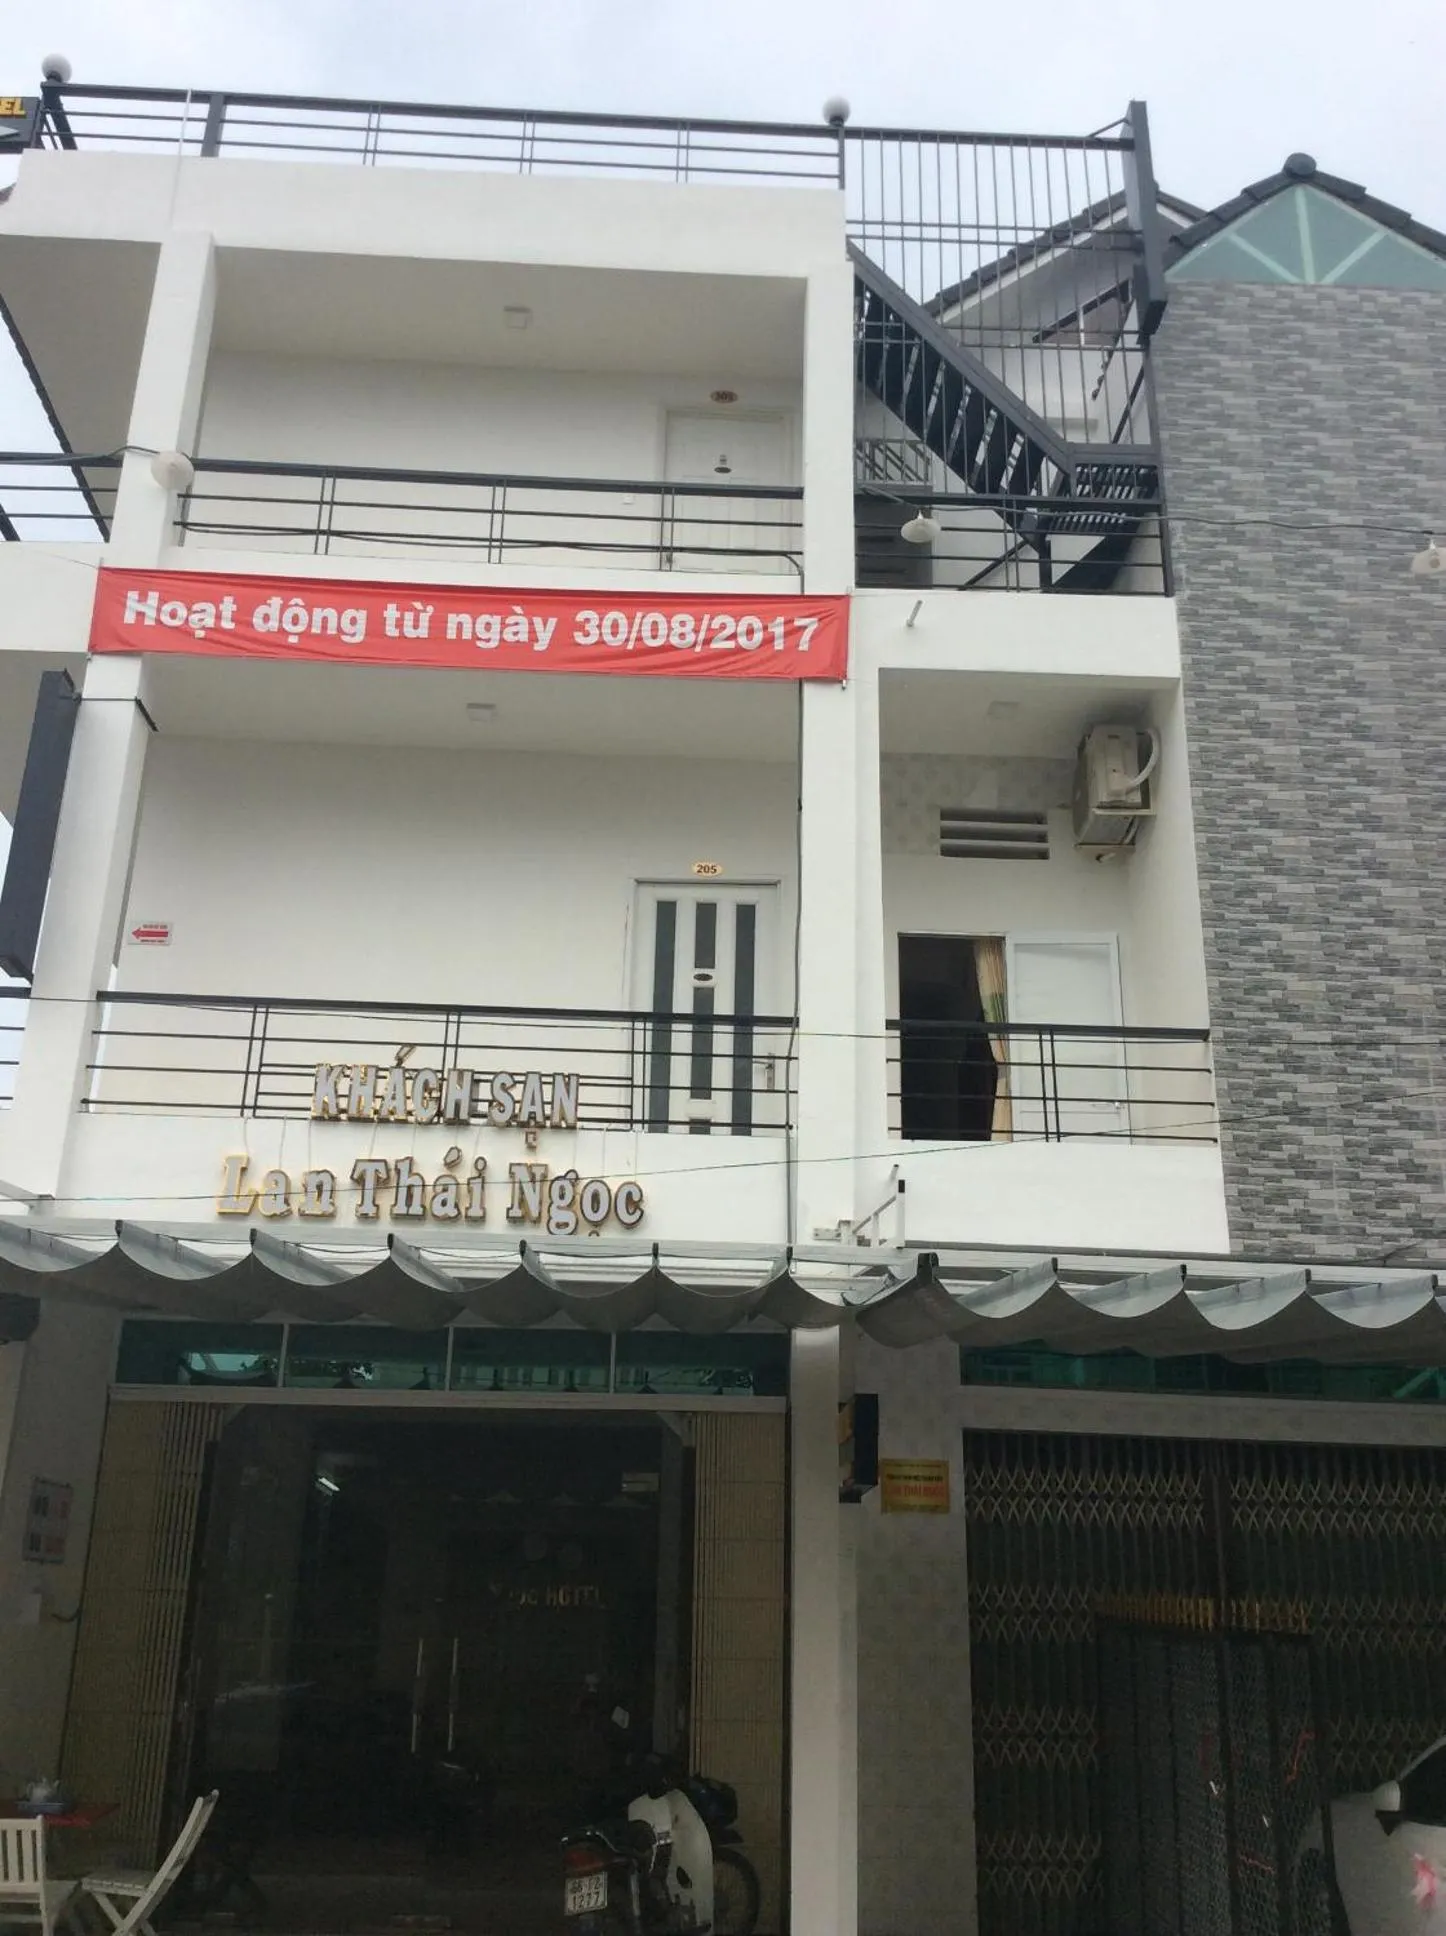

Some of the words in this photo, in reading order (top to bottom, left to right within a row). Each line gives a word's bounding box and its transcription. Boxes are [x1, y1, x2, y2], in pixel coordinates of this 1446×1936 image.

[123, 591, 237, 639] Hoạt
[252, 597, 368, 643] động
[384, 602, 434, 639] từ
[446, 606, 557, 652] ngày
[574, 610, 819, 652] 30/08/2017
[696, 863, 718, 875] 205
[311, 1043, 476, 1125] KHÁCH
[489, 1071, 580, 1148] SẠN
[216, 1154, 338, 1218] Lan
[350, 1146, 488, 1219] Thái
[506, 1162, 645, 1237] Ngọc
